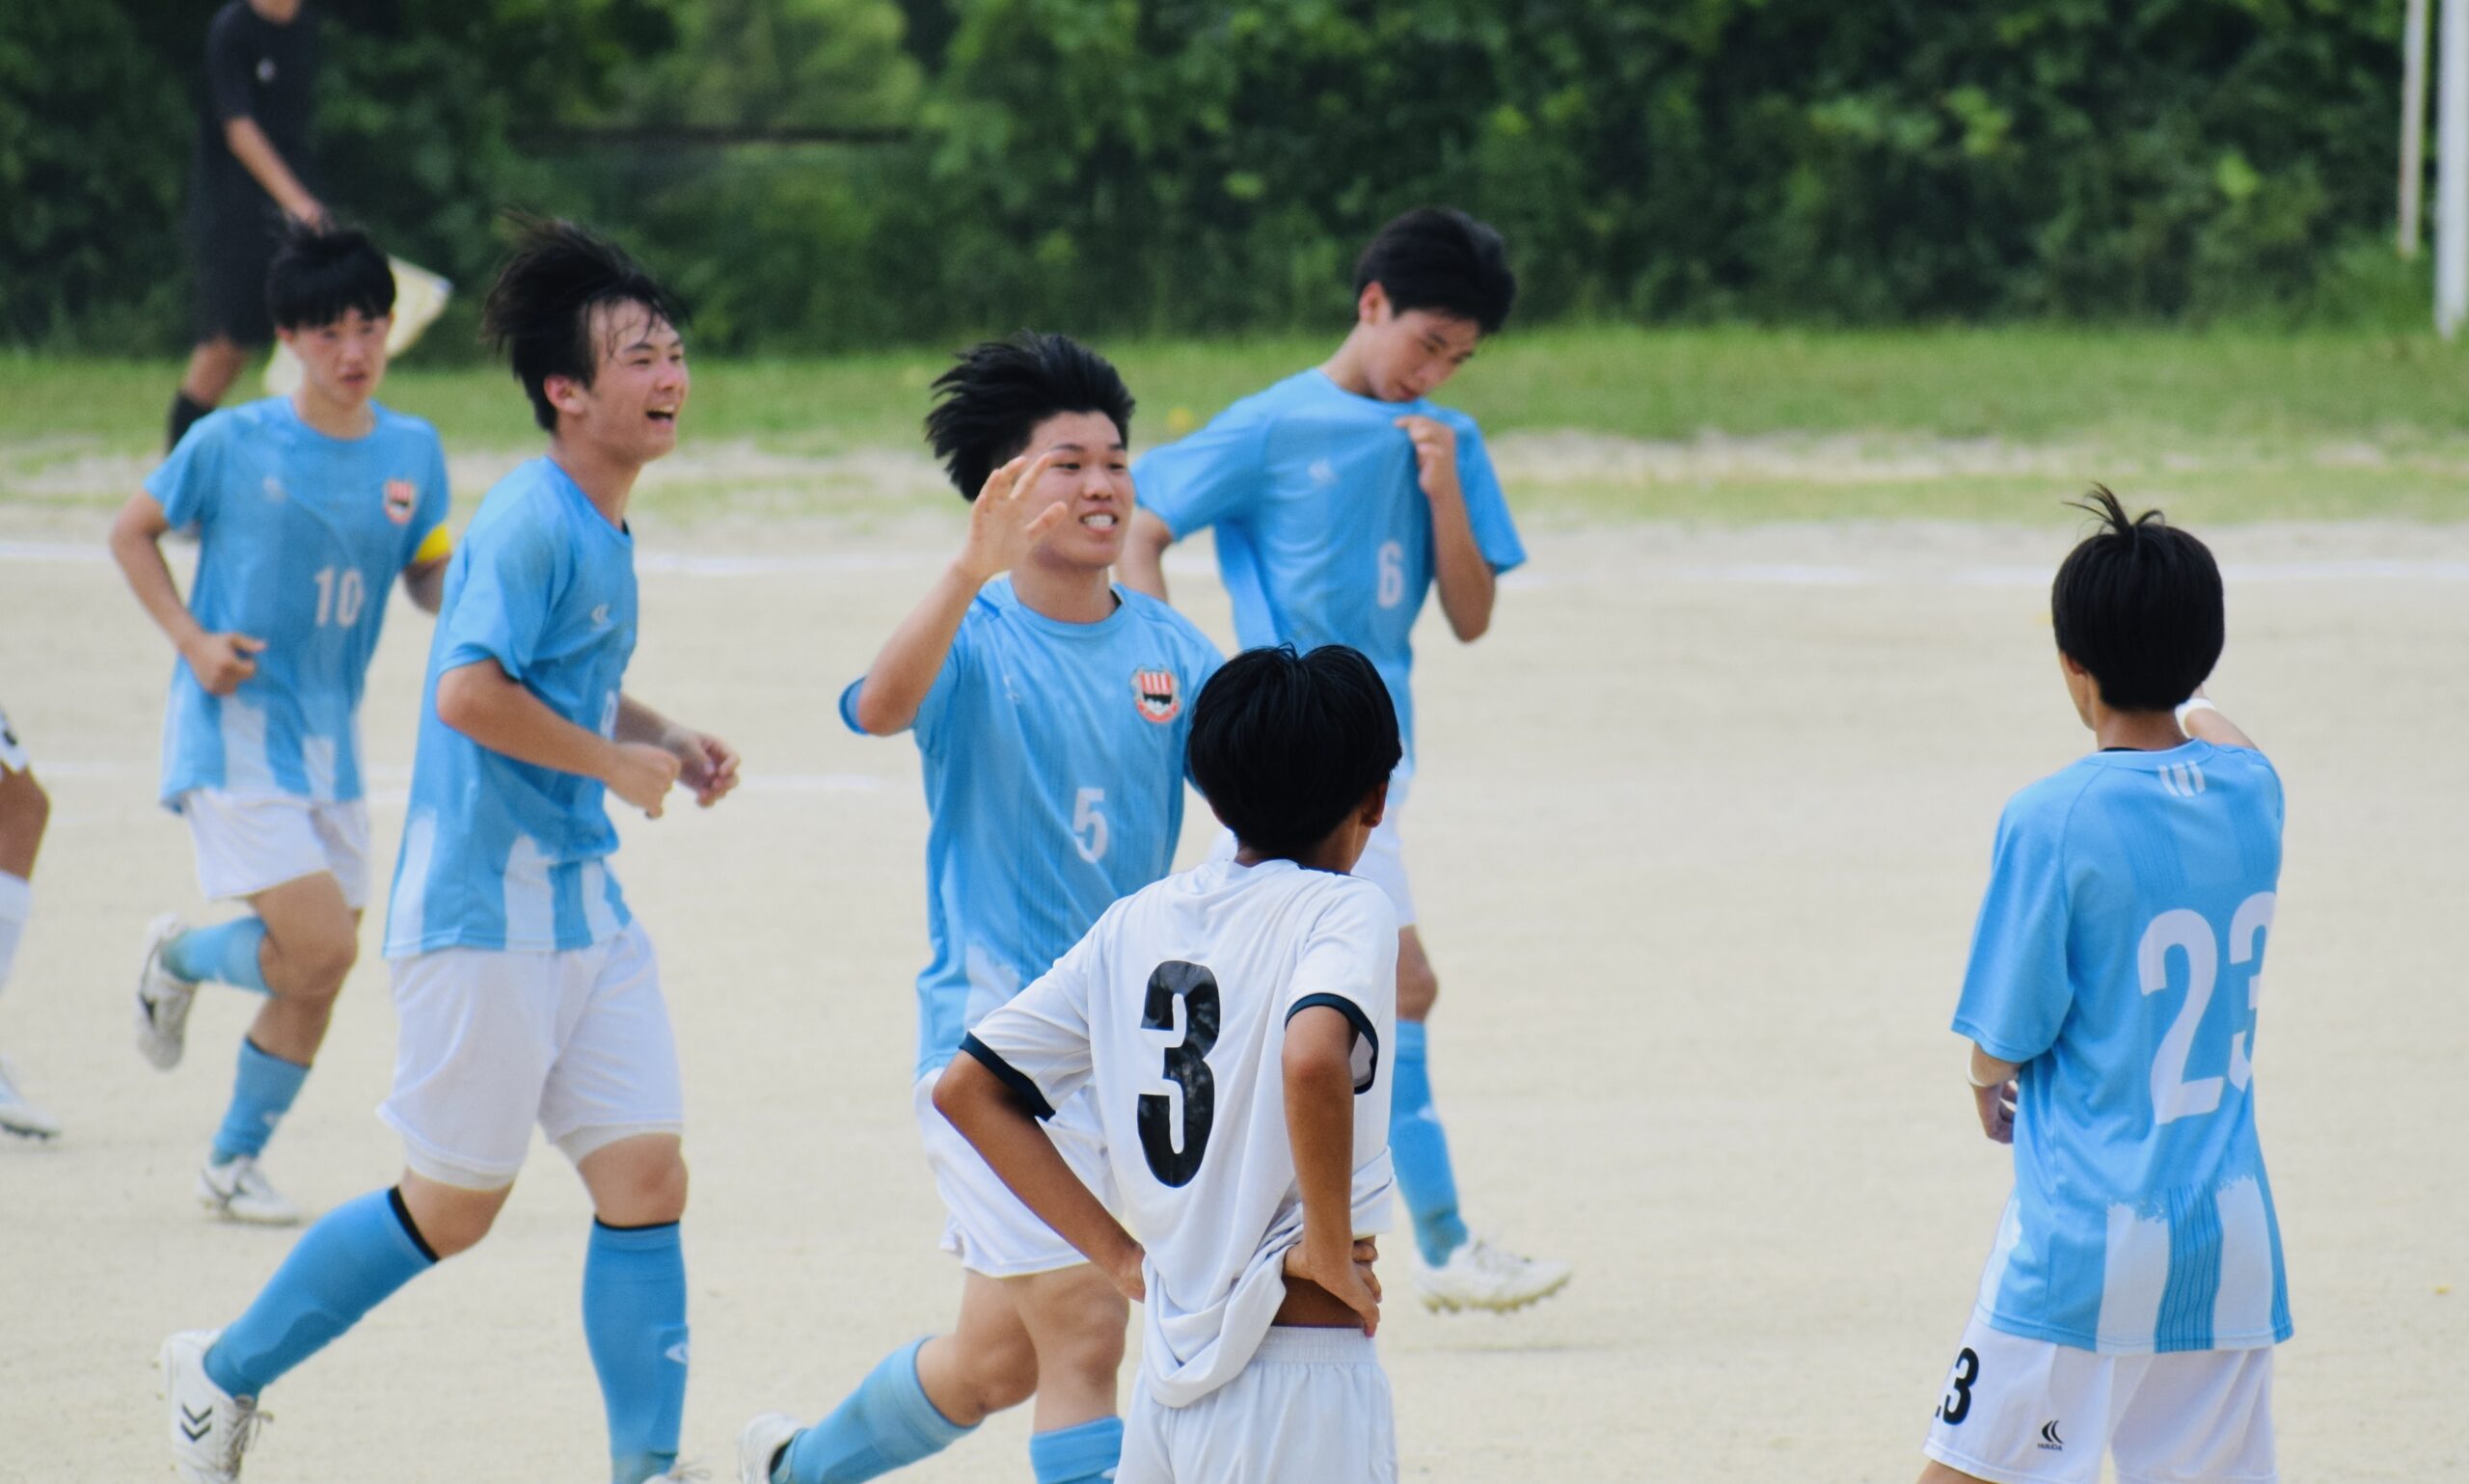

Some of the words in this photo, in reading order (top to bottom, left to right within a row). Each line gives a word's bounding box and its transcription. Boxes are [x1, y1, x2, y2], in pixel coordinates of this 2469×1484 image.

[313, 566, 366, 629] 10
[1377, 540, 1404, 608] 6
[1072, 787, 1108, 864] 5
[1137, 959, 1221, 1188] 3
[1935, 1346, 1980, 1425] 3
